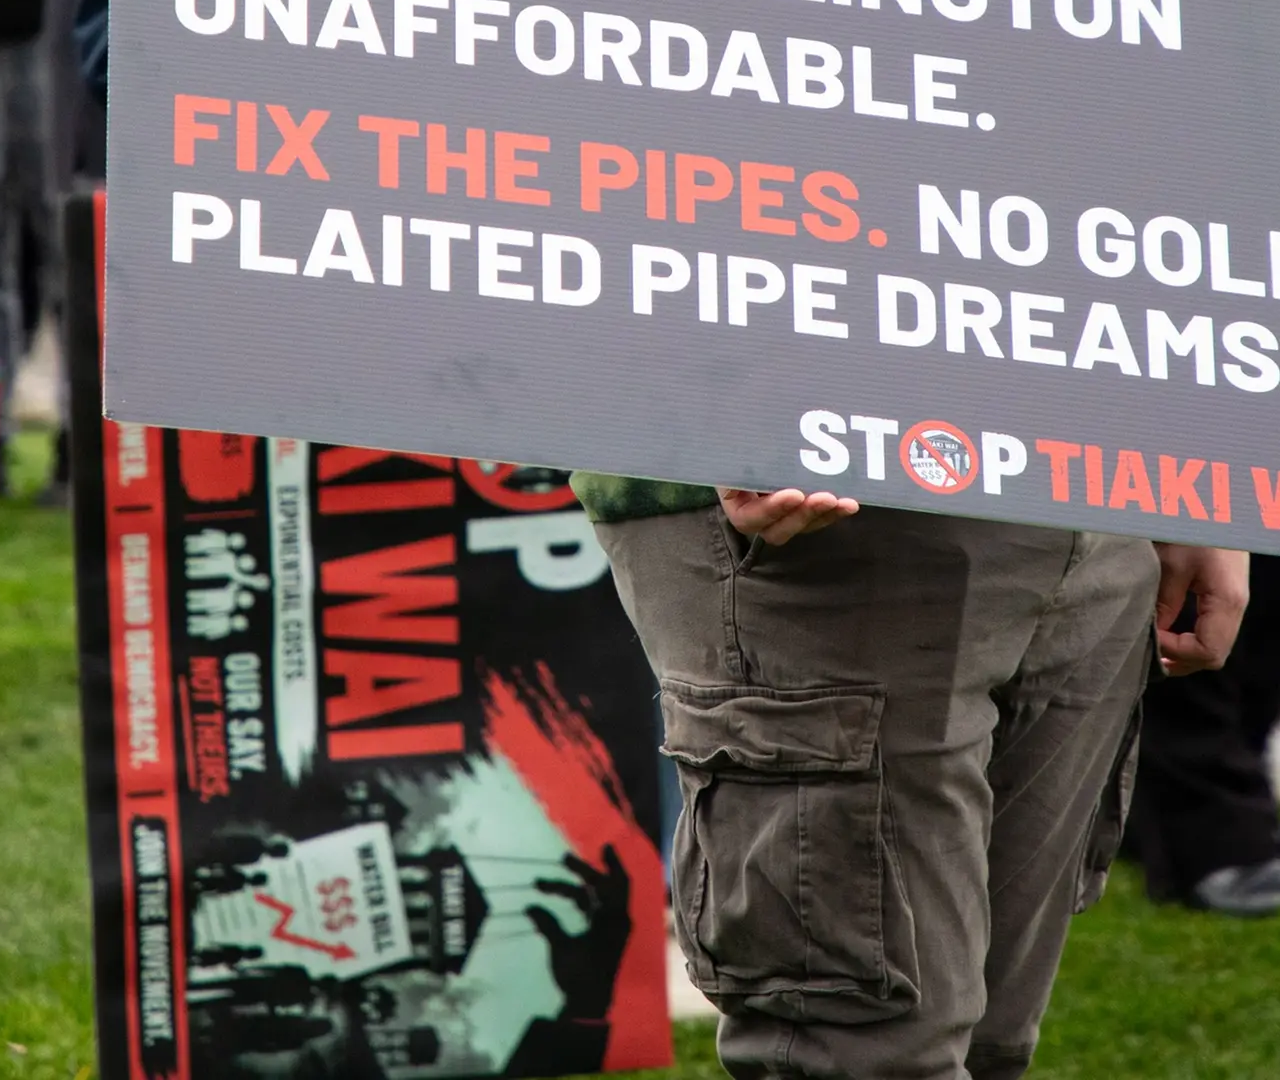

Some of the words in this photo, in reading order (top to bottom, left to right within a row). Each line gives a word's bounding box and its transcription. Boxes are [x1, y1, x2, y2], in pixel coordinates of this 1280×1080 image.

[173, 94, 331, 181] FIX
[358, 115, 552, 206] THE
[579, 141, 889, 248] PIPES.
[918, 183, 1050, 267] NO
[171, 191, 603, 308] PLAITED
[631, 243, 850, 339] PIPE
[799, 409, 1028, 495] STOP
[1035, 438, 1231, 523] TIAKI
[120, 532, 153, 625] DEMAND
[276, 484, 302, 612] EXPONENTIAL
[188, 655, 222, 706] NOT
[223, 652, 262, 712] OUR
[320, 532, 466, 761] WAI
[123, 629, 158, 770] DEMOCRACY.
[193, 711, 231, 804] THEIRS.
[227, 717, 267, 781] SAY.
[134, 824, 168, 877] JOIN
[355, 841, 389, 909] WATER
[138, 877, 169, 921] THE
[368, 911, 396, 954] BILL
[140, 923, 173, 1047] MOVEMENT.
